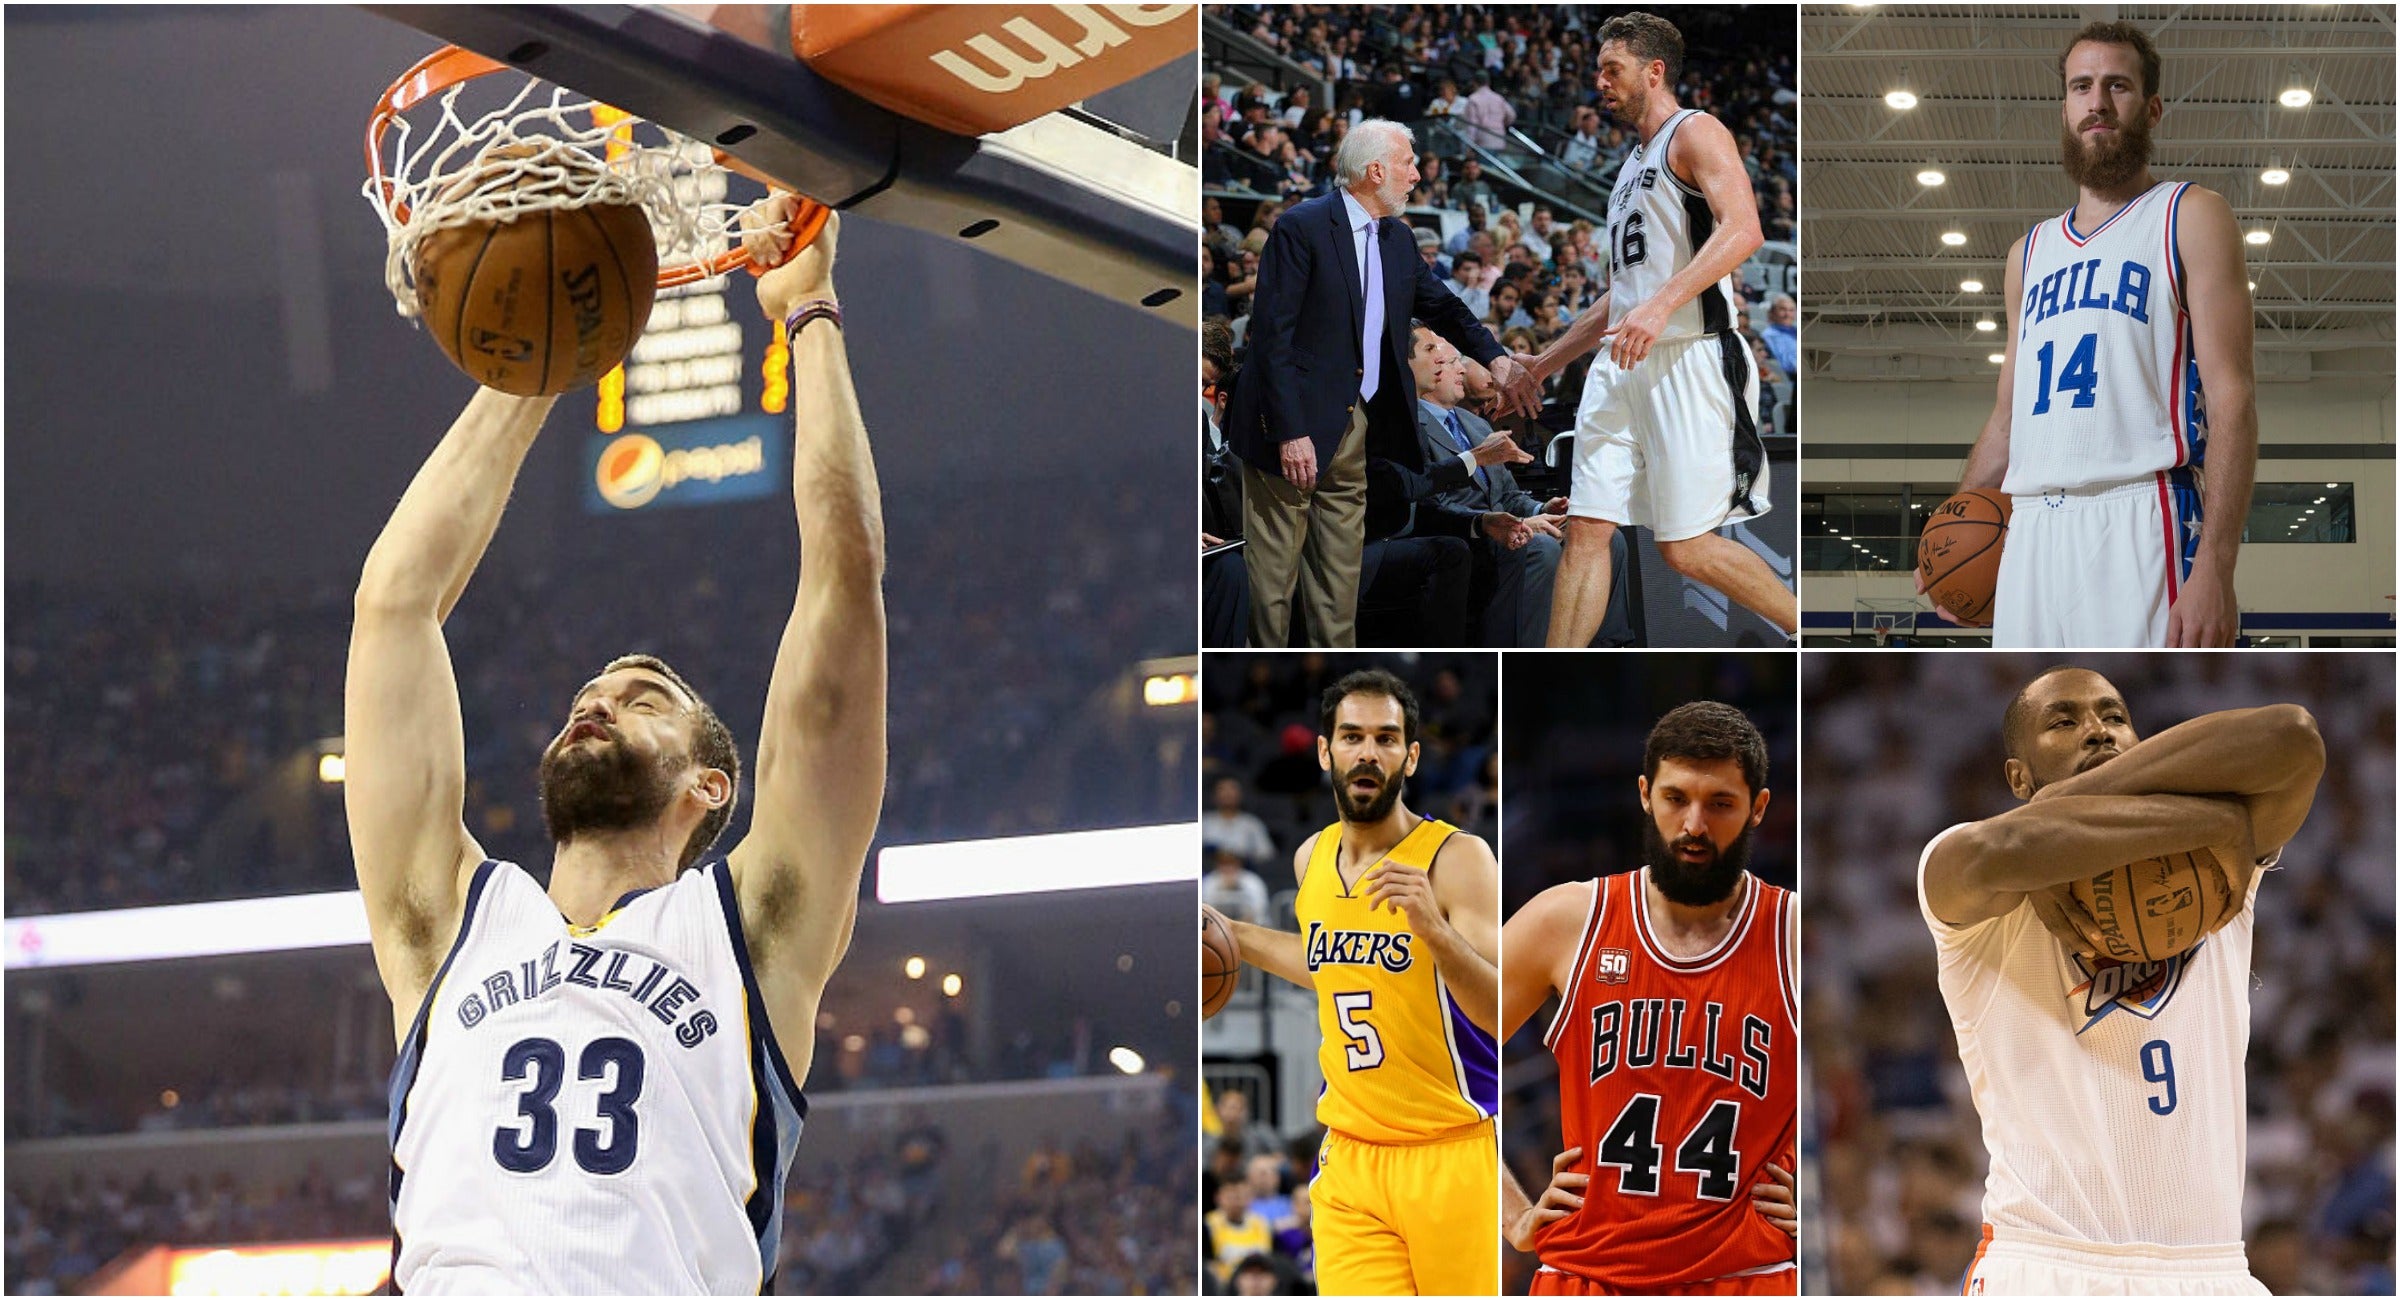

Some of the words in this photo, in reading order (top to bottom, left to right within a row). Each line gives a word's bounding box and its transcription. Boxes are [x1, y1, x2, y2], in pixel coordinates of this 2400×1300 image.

[1611, 209, 1648, 275] 16
[2022, 258, 2151, 342] PHILA
[2032, 333, 2098, 415] 14
[1306, 921, 1415, 974] LAKERS
[1600, 953, 1628, 975] 50
[458, 940, 719, 1049] GRIZZLIES
[1333, 990, 1385, 1072] 5
[1590, 998, 1771, 1100] BULLS
[2139, 1038, 2178, 1116] 9
[492, 1037, 646, 1176] 33
[1597, 1092, 1741, 1202] 44
